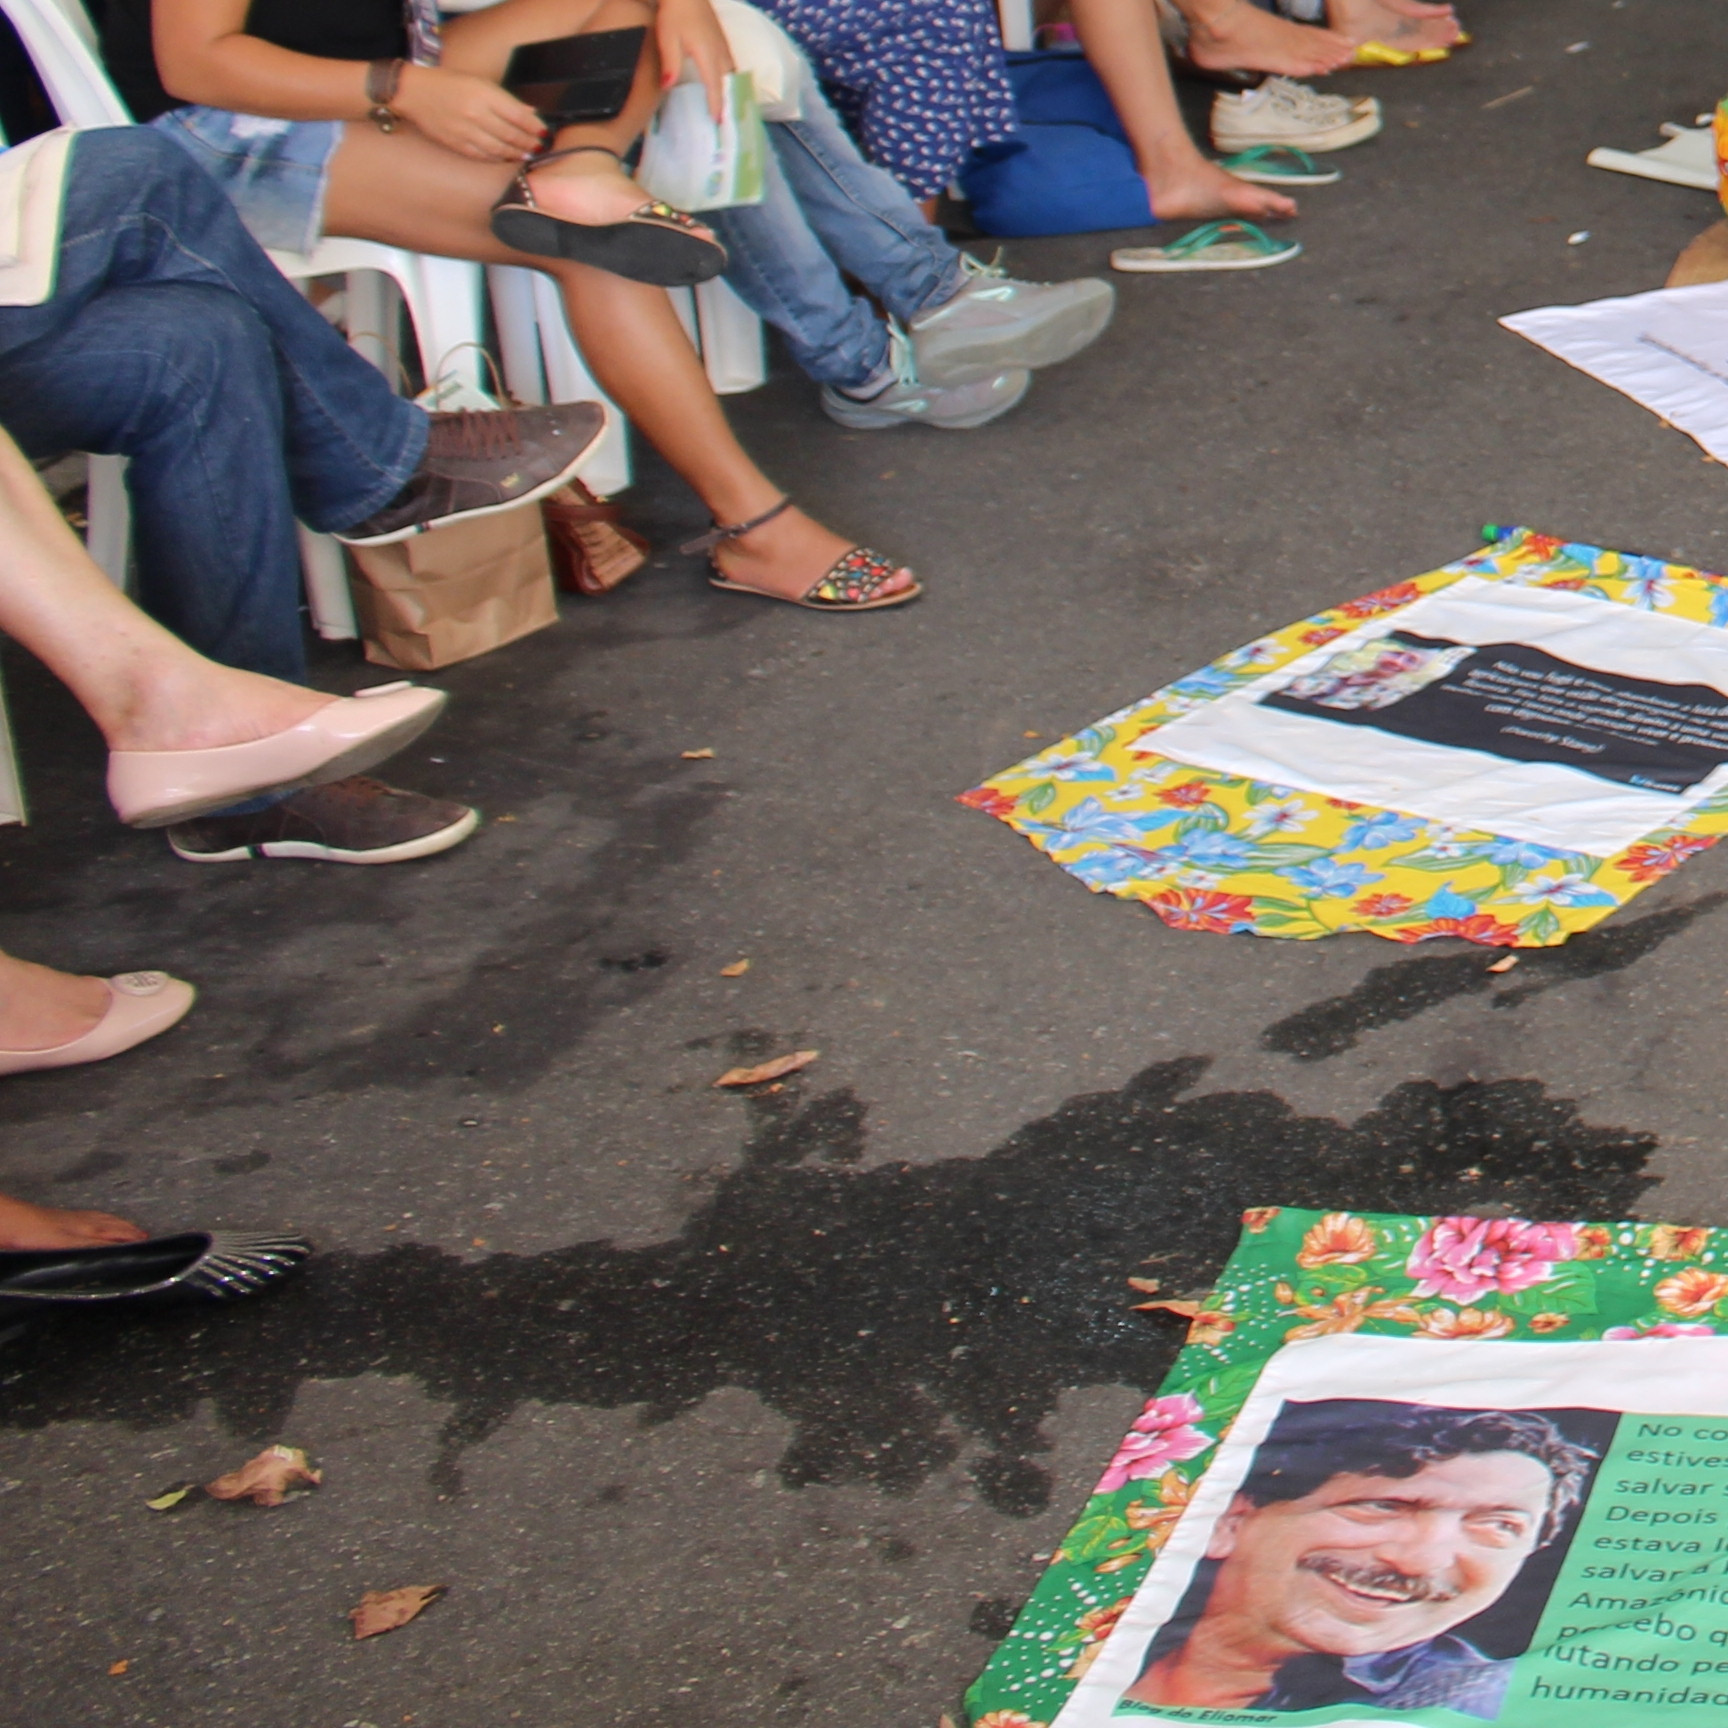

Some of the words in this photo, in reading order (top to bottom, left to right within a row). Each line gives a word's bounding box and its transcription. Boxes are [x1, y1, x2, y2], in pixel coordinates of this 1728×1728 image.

[1636, 1422, 1684, 1439] No
[1614, 1476, 1715, 1498] salvar
[1604, 1504, 1719, 1528] Depois
[1592, 1535, 1703, 1555] estava
[1580, 1562, 1685, 1583] salvar
[1689, 1563, 1710, 1576] a
